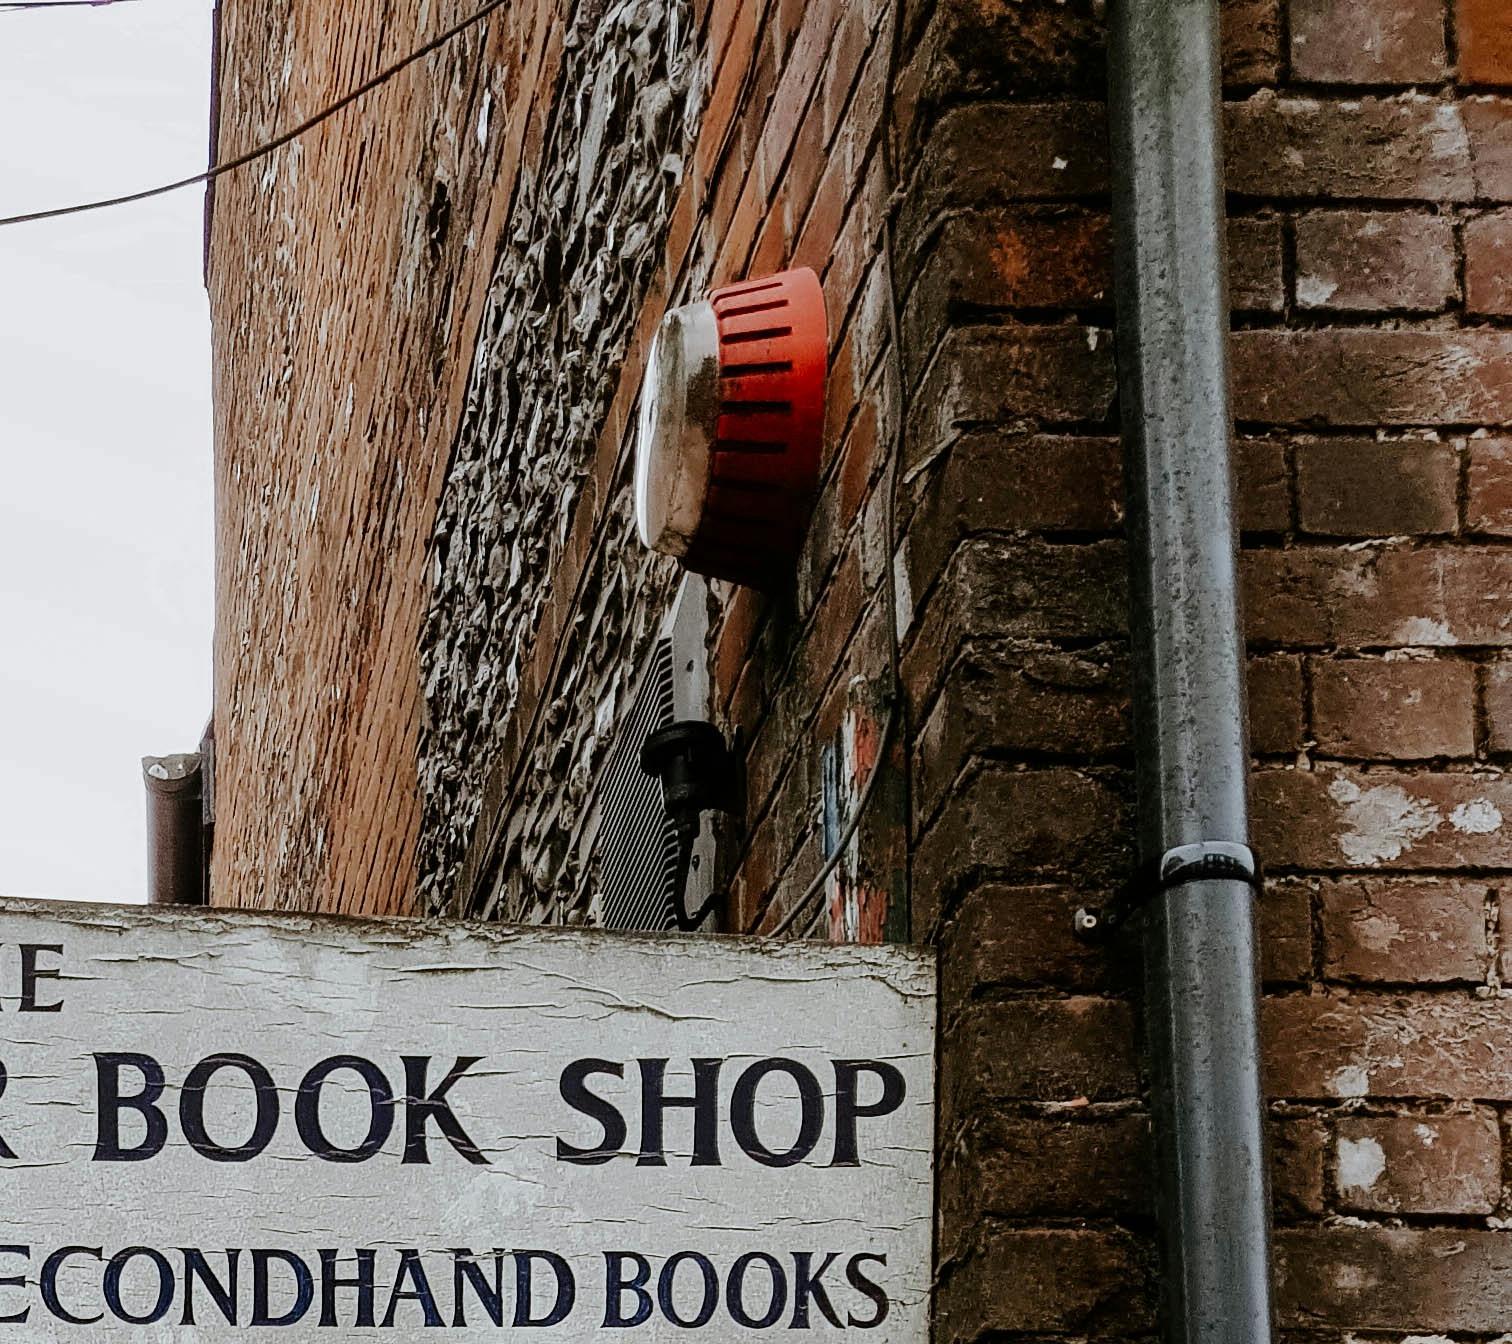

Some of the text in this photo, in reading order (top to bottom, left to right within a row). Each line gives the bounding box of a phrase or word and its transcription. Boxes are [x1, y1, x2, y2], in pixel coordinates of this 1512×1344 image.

[93, 1052, 489, 1165] BOOK
[555, 1056, 906, 1168] SHOP
[602, 1250, 890, 1331] BOOKS
